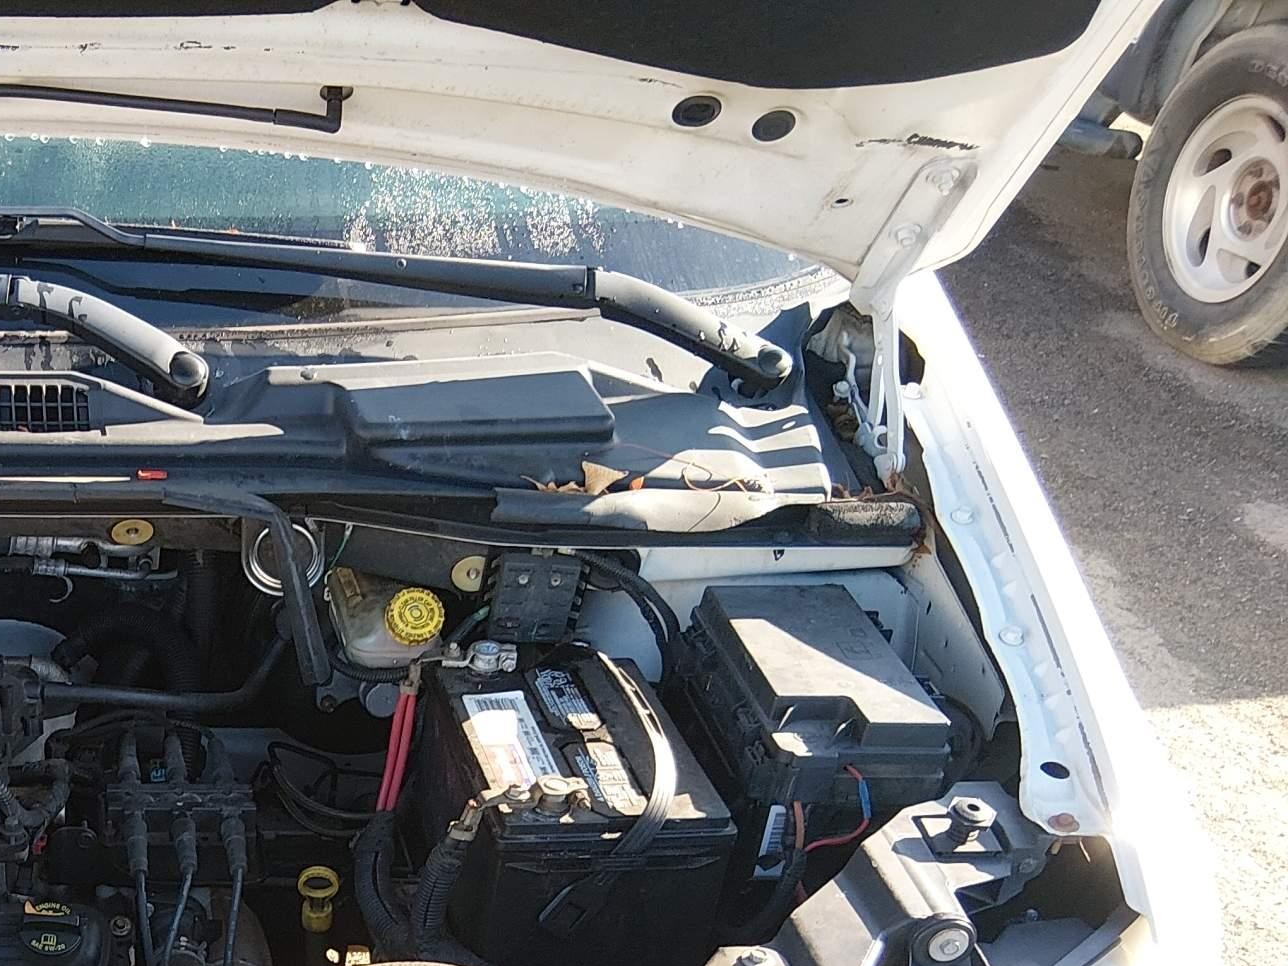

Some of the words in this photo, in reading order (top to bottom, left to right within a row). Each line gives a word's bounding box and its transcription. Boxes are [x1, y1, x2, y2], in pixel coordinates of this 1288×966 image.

[35, 902, 61, 911] ENGINE
[61, 904, 72, 915] OIL
[30, 939, 44, 950] SAE
